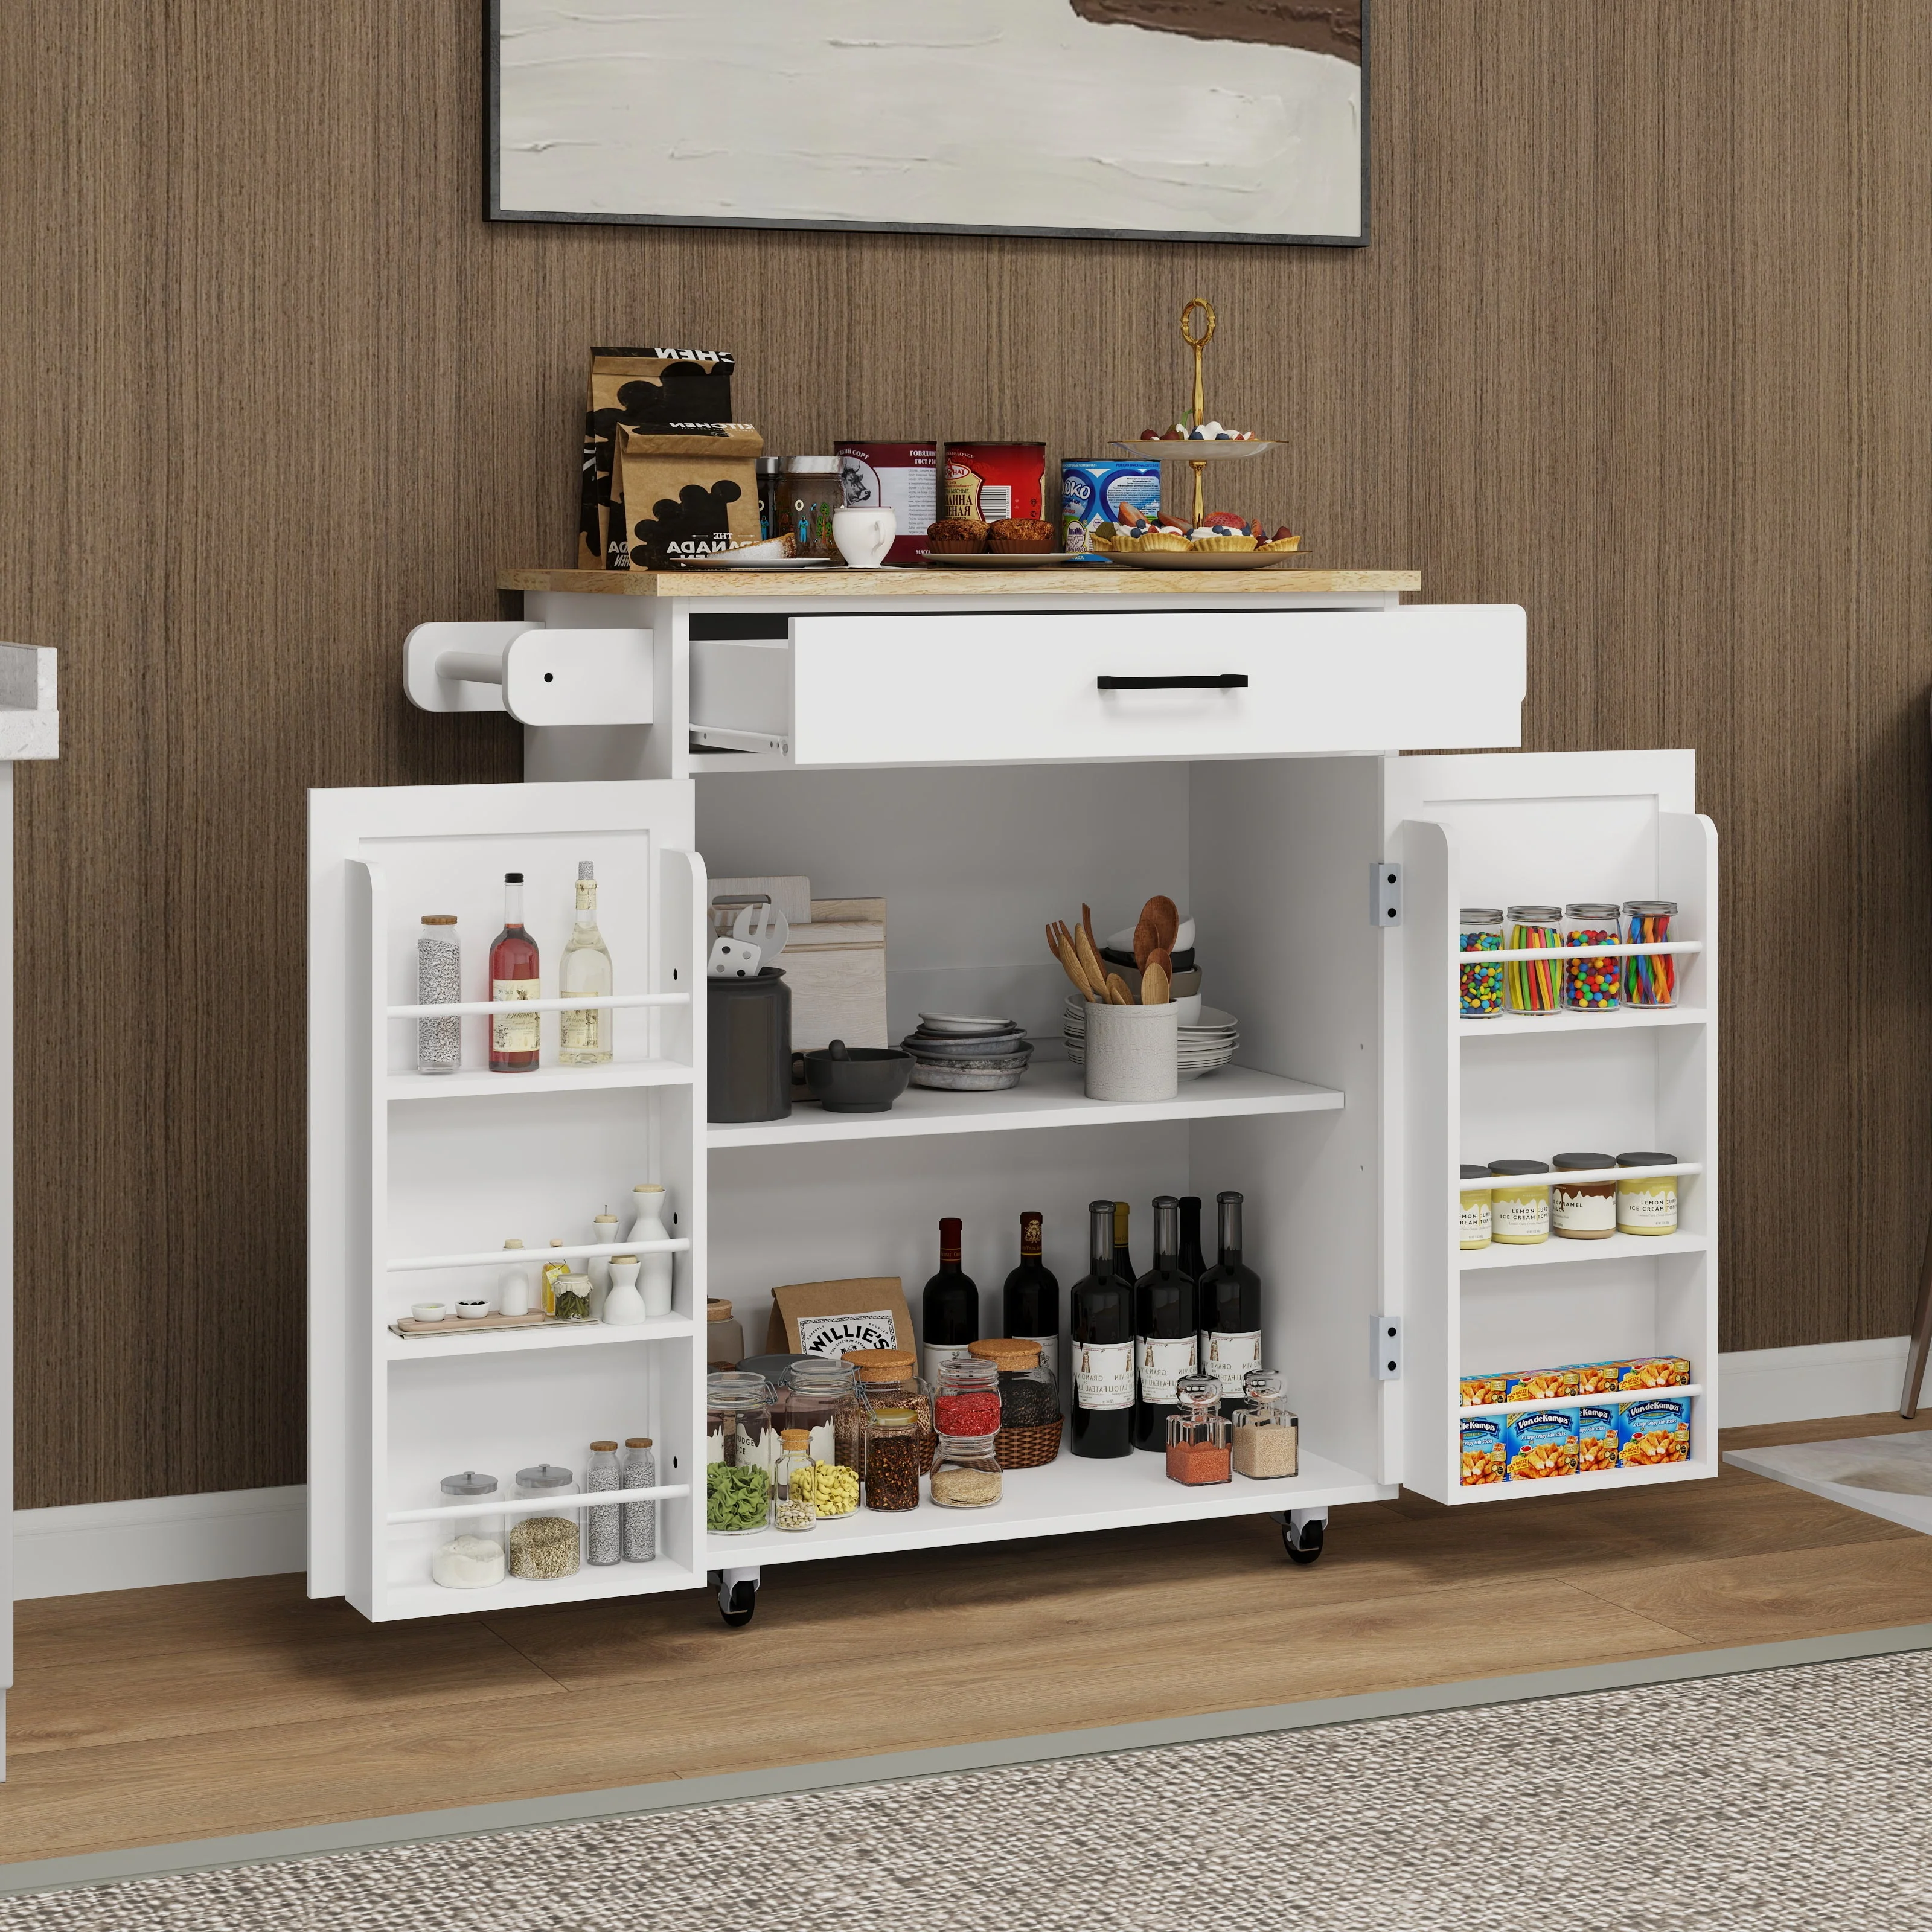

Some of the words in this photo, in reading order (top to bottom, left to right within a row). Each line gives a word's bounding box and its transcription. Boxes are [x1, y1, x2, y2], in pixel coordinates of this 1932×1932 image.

[852, 450, 869, 460] СОРТ
[807, 1325, 825, 1340] EXPERTLY
[869, 1322, 889, 1335] SOURCED
[1630, 1406, 1646, 1416] Van
[1654, 1401, 1679, 1411] Kamp's
[1518, 1419, 1534, 1429] Van
[1543, 1414, 1569, 1424] Kamp's
